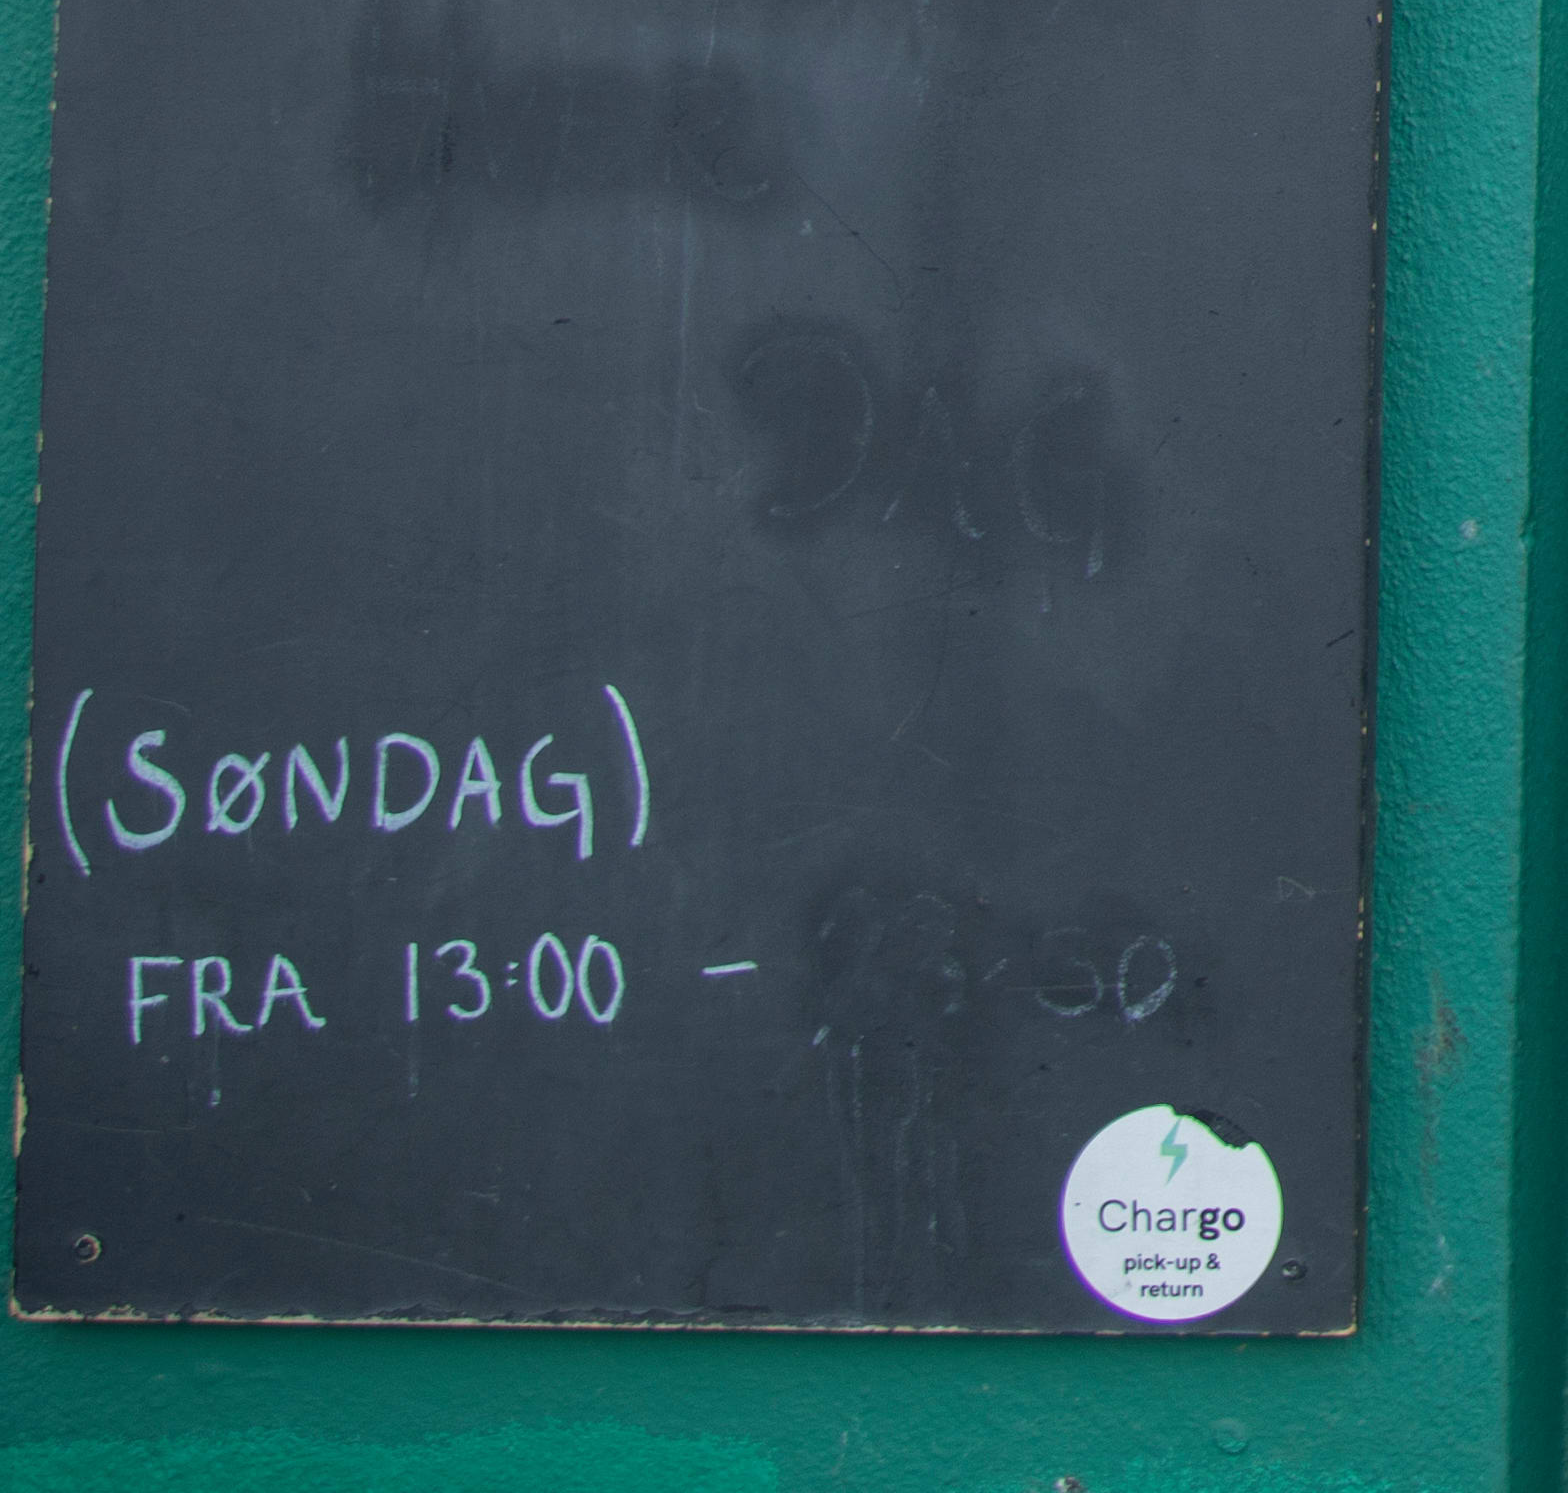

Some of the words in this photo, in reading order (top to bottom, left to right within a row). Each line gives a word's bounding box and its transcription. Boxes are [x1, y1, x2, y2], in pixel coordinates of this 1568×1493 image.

[129, 954, 325, 1044] FRA
[405, 931, 624, 1024] 13:00
[1098, 1199, 1246, 1241] Chargo
[1124, 1254, 1202, 1275] pick-up
[1207, 1253, 1221, 1271] &
[1140, 1281, 1204, 1298] return
